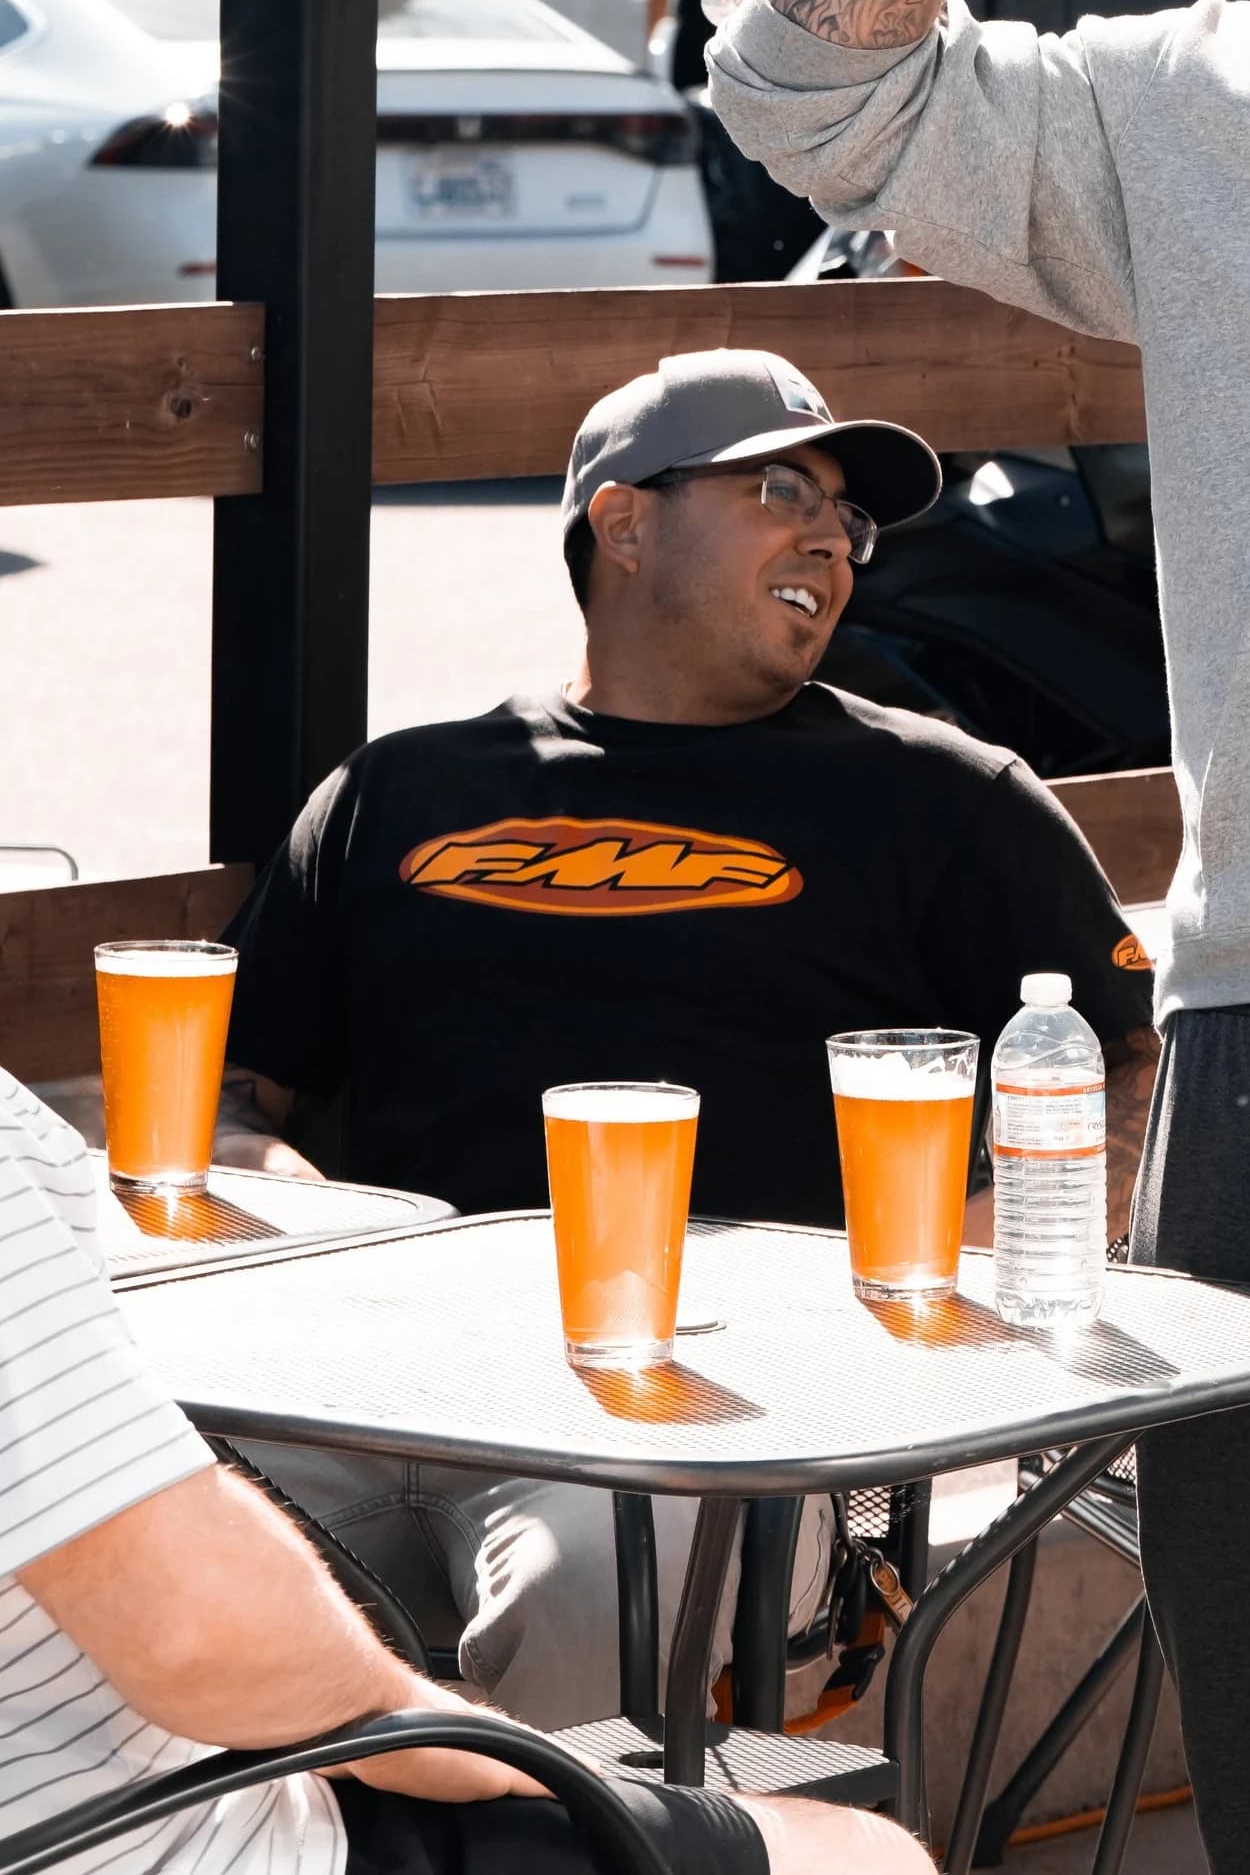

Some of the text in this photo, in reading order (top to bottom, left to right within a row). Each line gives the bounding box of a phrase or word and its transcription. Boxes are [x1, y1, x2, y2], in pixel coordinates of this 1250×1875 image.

[409, 837, 793, 890] FMF
[1118, 943, 1147, 966] FM
[1087, 1119, 1105, 1133] CRYS
